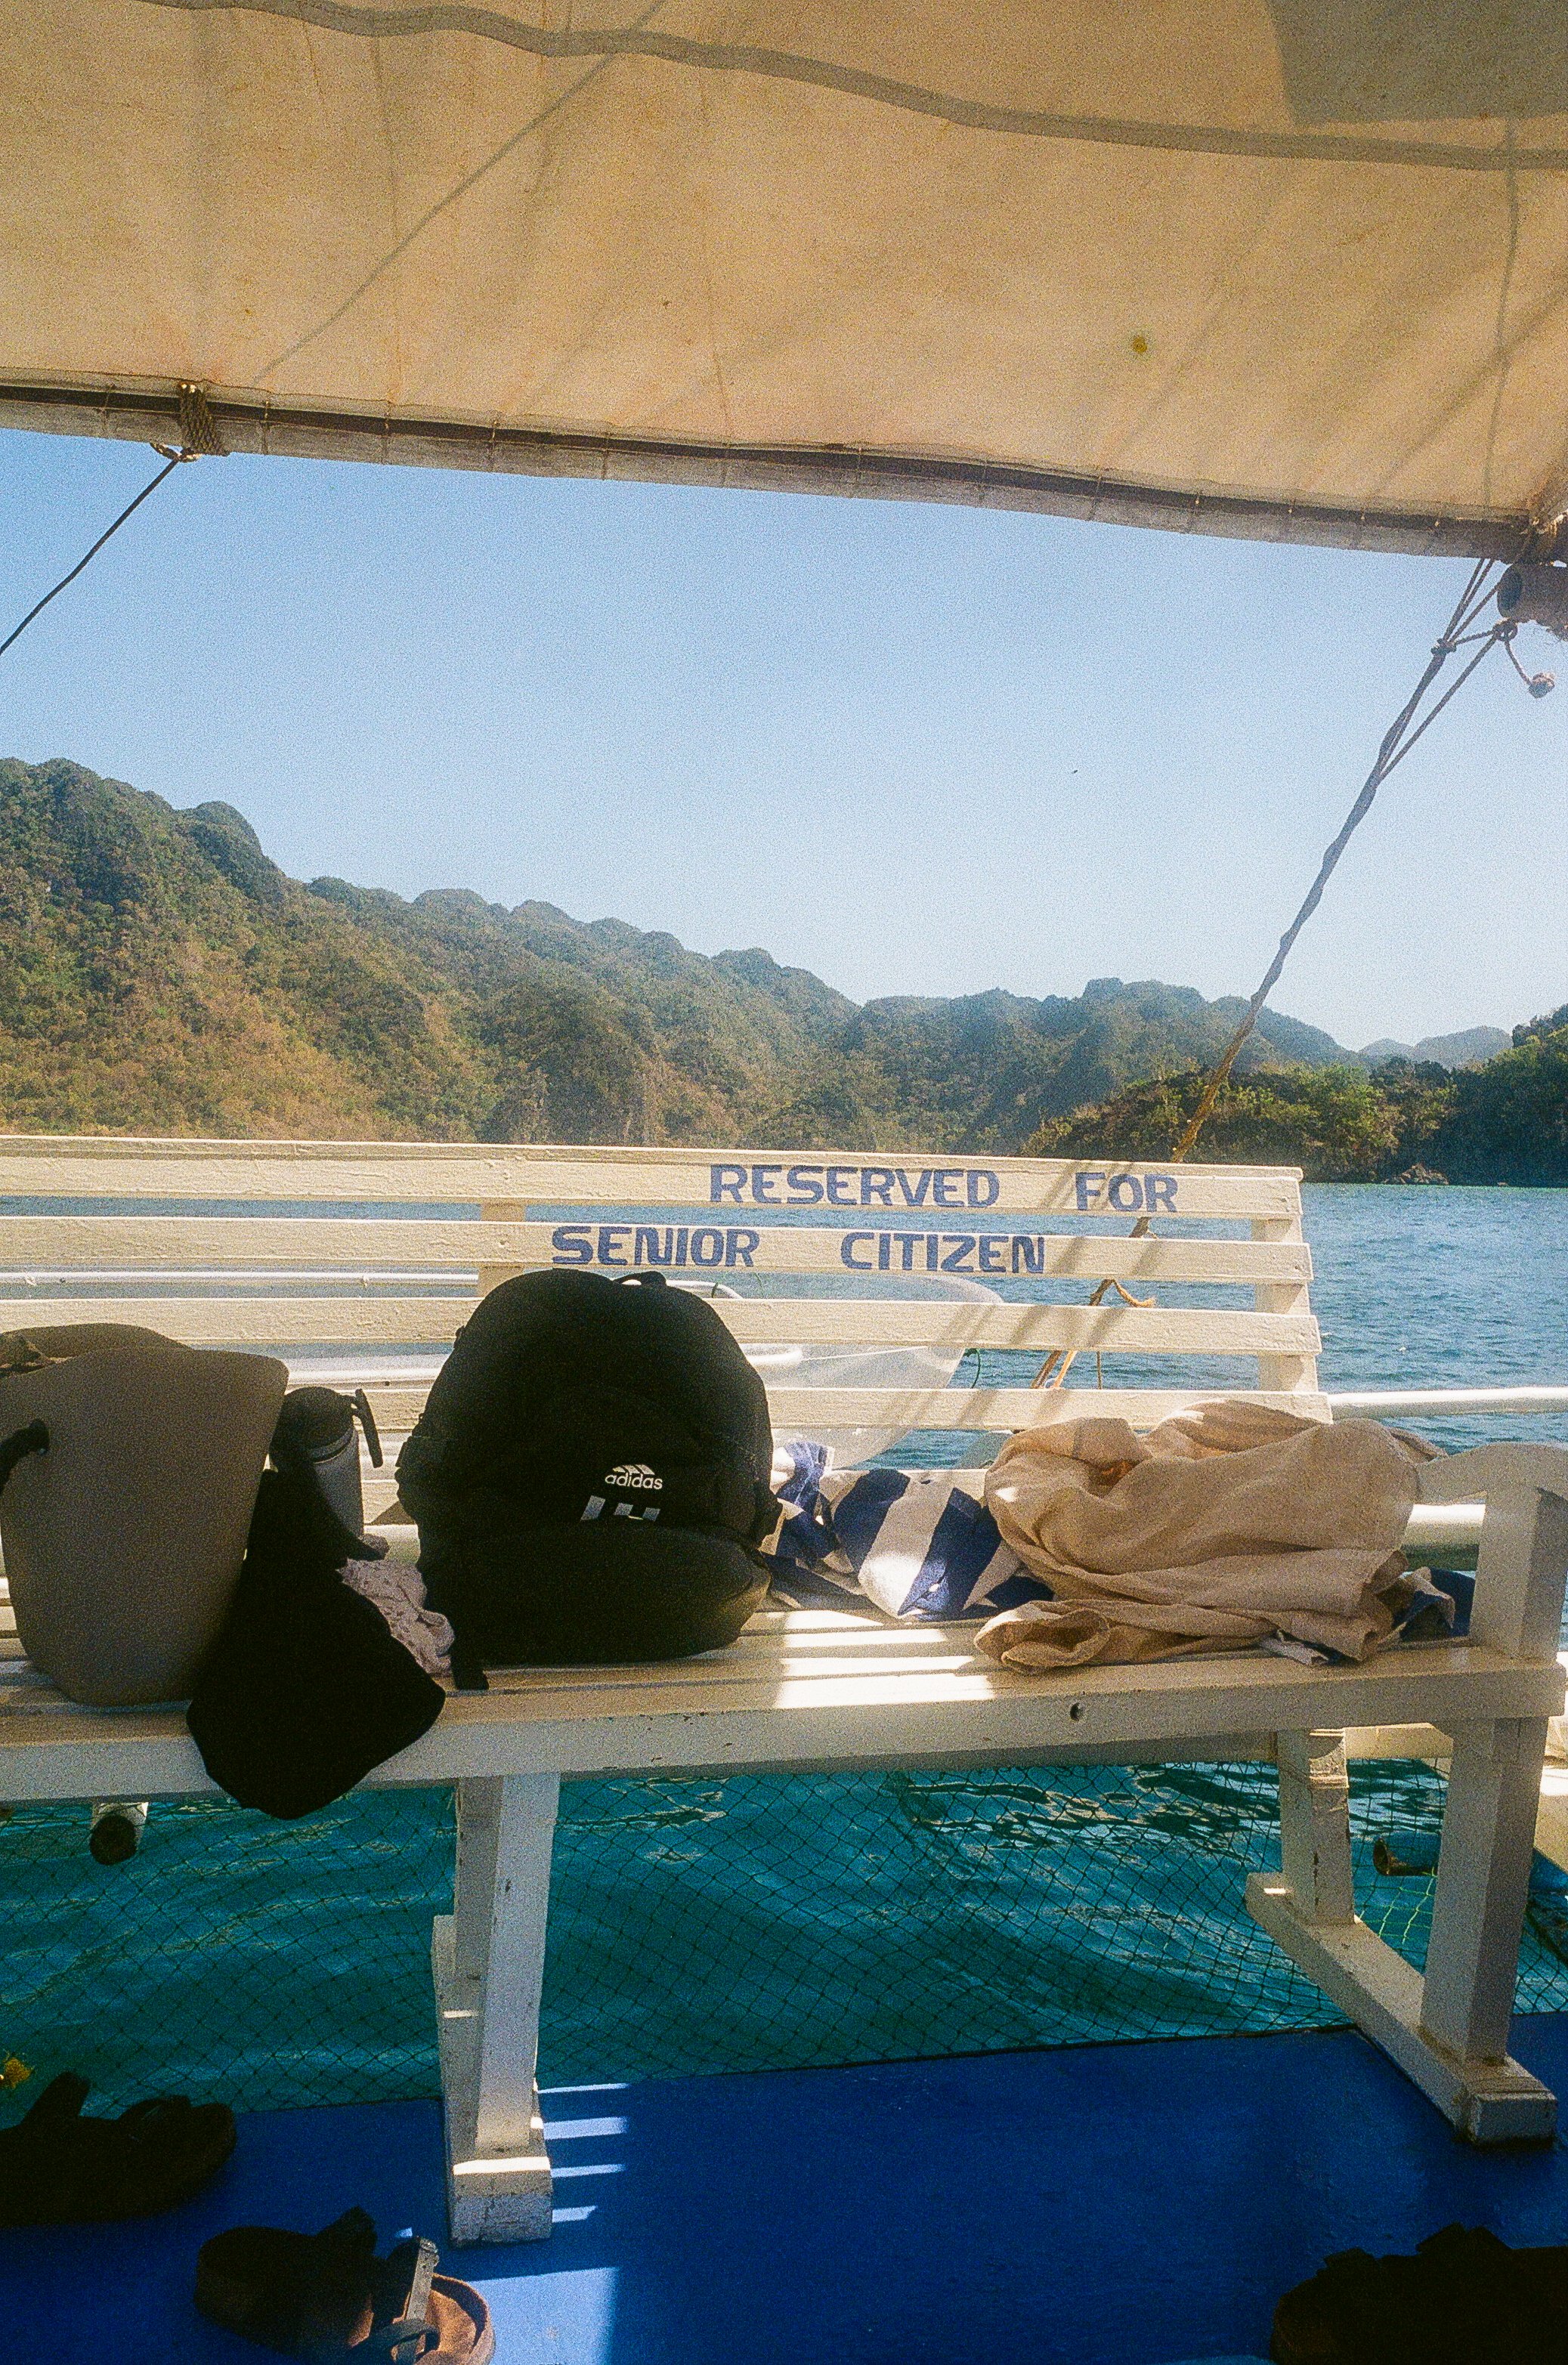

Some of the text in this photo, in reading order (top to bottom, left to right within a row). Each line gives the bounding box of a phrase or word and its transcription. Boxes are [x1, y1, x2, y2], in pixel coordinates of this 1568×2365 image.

[710, 1164, 1179, 1213] RESERVED FOR
[551, 1225, 1046, 1275] SENIOR CITIZEN
[605, 1472, 663, 1490] adidas
